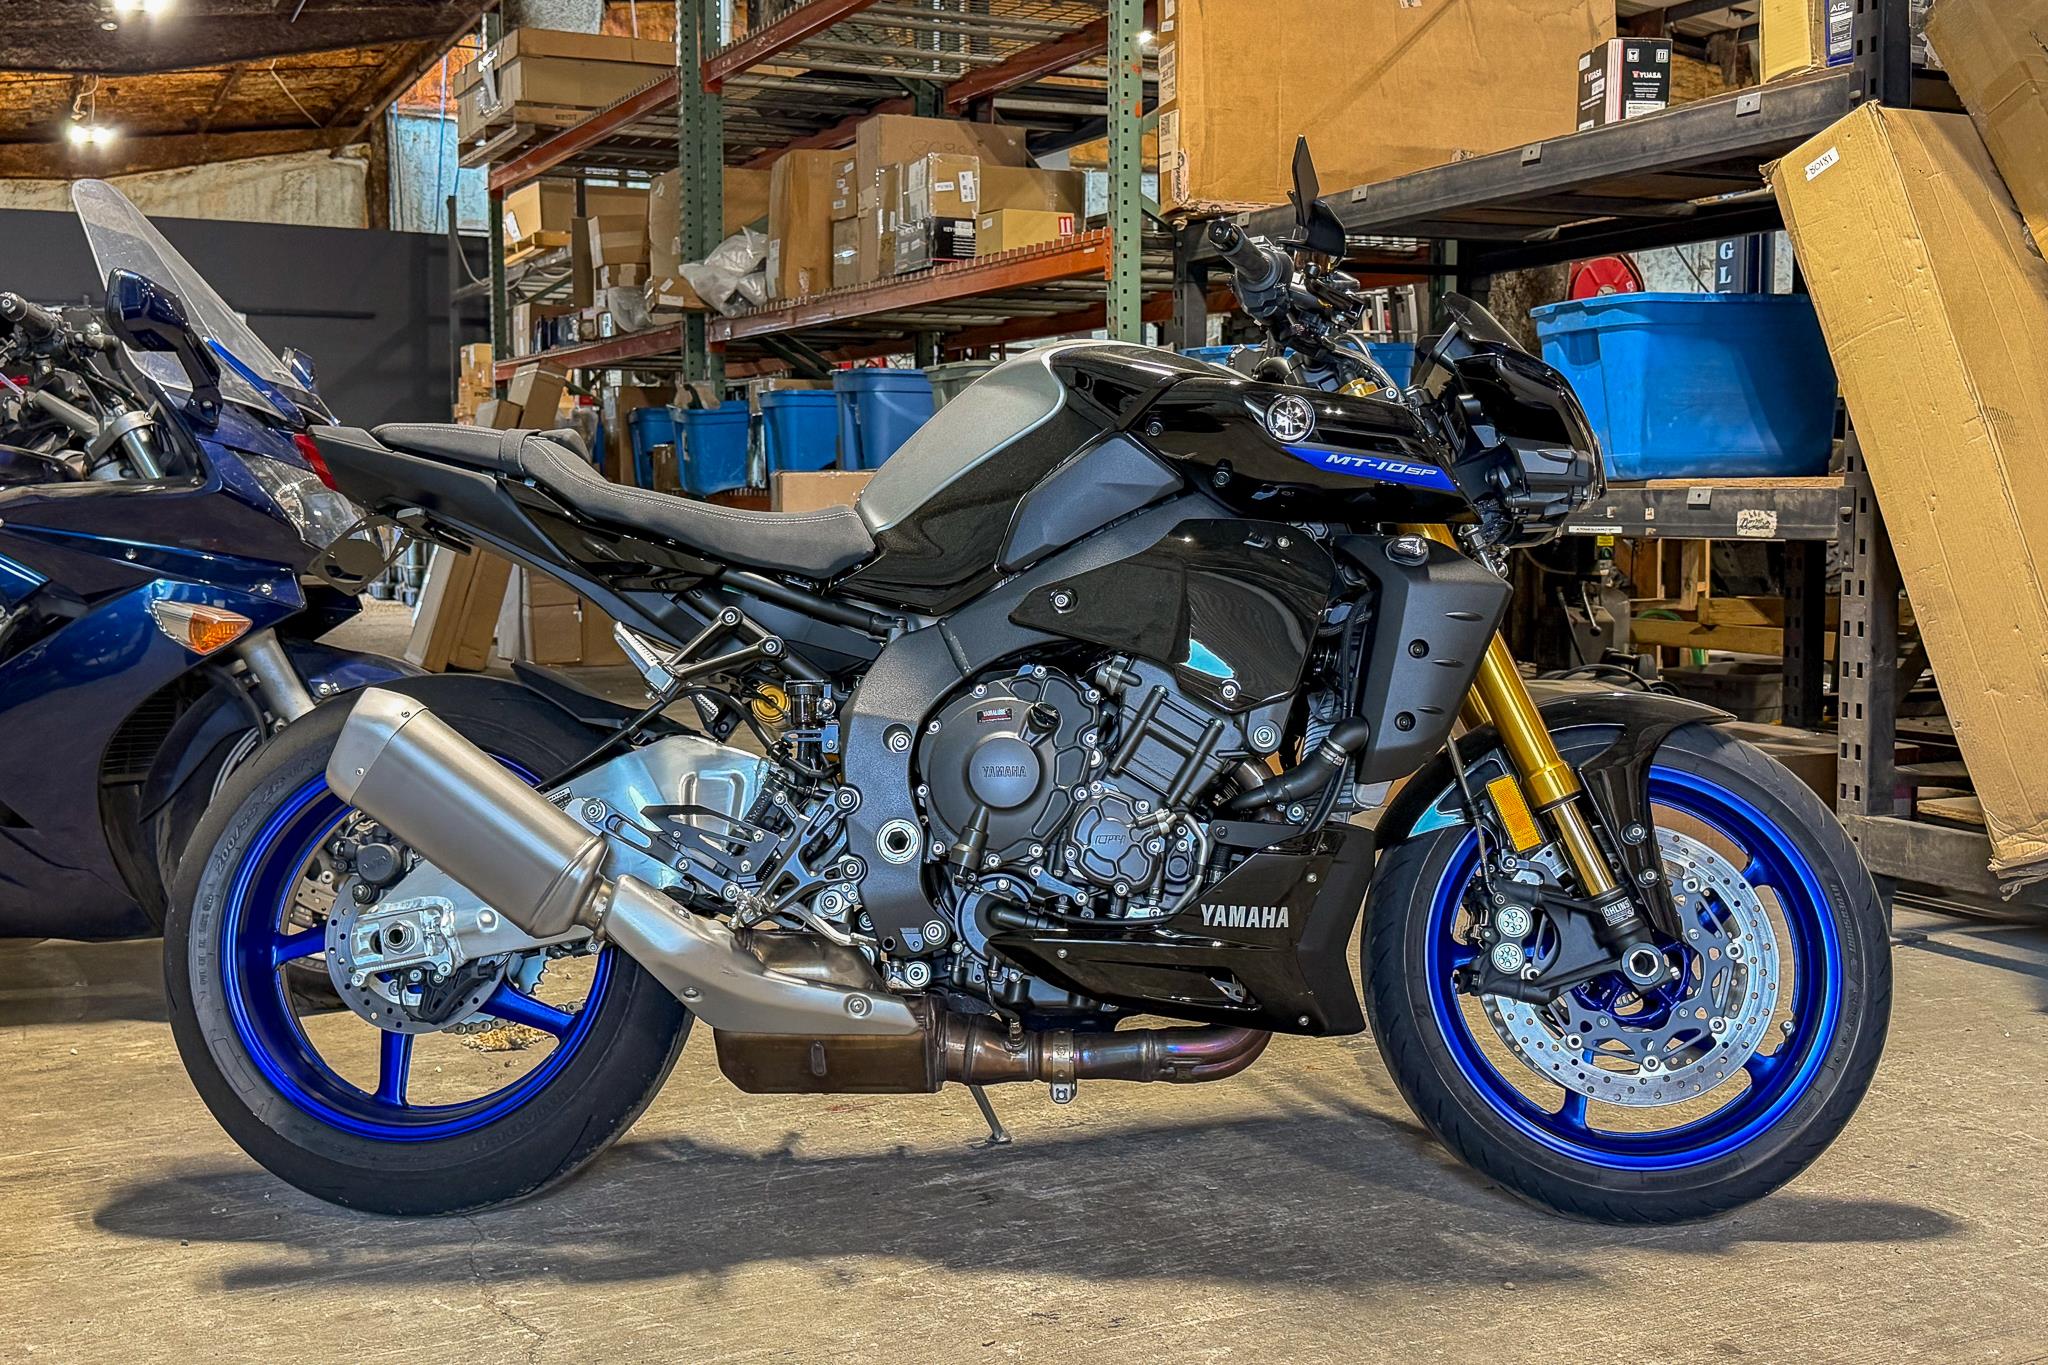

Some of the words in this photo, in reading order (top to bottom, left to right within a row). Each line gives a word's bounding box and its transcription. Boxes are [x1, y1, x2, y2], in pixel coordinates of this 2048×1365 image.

[1640, 71, 1662, 79] YUASA
[982, 765, 1028, 778] YAMAHA
[1200, 904, 1289, 928] YAMAHA
